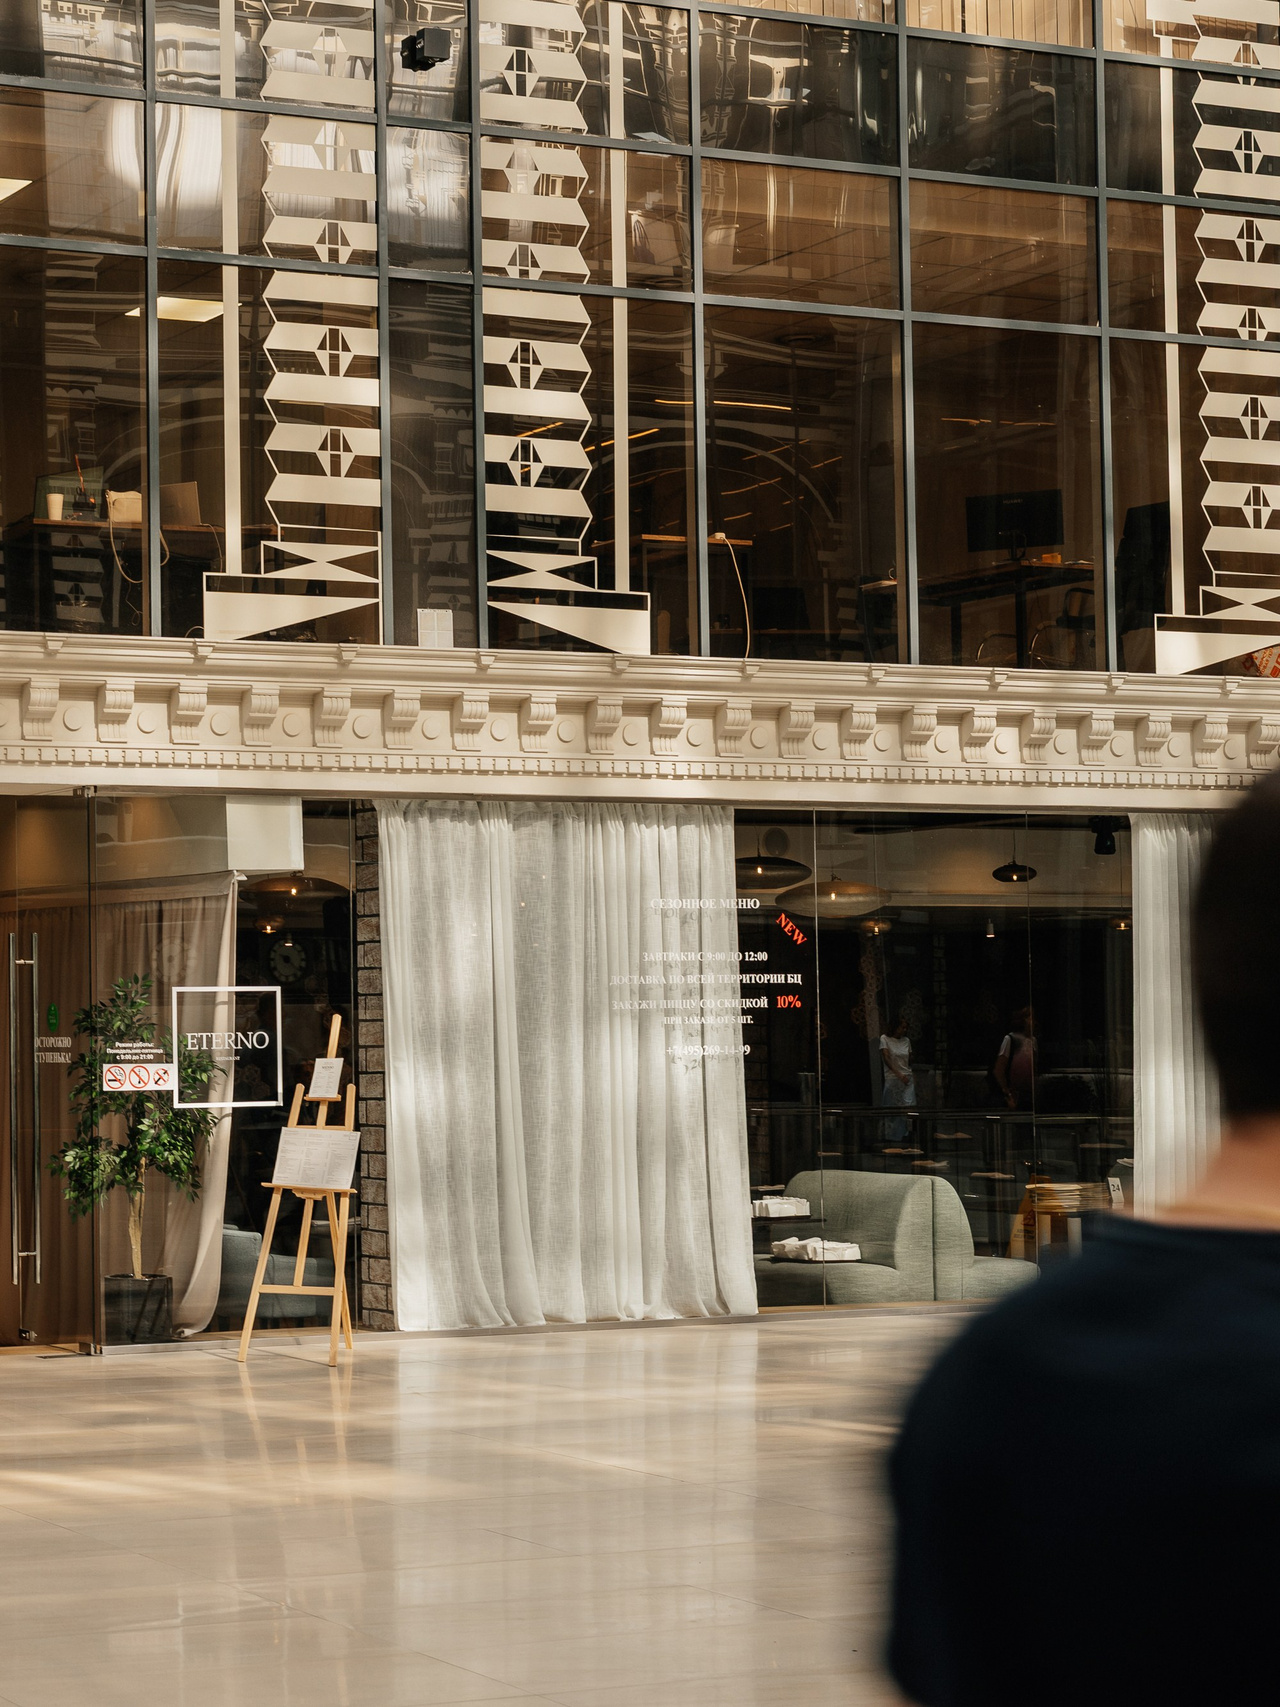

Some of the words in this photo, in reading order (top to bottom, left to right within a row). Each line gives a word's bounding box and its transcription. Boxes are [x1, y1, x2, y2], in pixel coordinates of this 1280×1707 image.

[650, 898, 717, 909] СЕЗОННОЕ
[720, 898, 760, 909] МЕНЮ
[775, 912, 808, 945] NEW
[642, 952, 695, 962] ЗАВТРАКИ
[697, 952, 705, 961] С
[707, 951, 726, 961] 9:00
[728, 952, 743, 962] ДО
[744, 951, 768, 961] 12:00
[609, 975, 667, 986] ДОСТАВКА
[669, 974, 685, 984] ПО
[687, 972, 715, 984] ВСЕЙ
[717, 973, 786, 984] ТЕРРИТОРИИ
[787, 973, 803, 985] БЦ
[612, 1000, 657, 1010] ЗАКАЖИ
[660, 999, 698, 1010] ПИЦЦУ
[700, 998, 715, 1009] СО
[717, 996, 769, 1010] СКИДКОЙ
[776, 995, 802, 1008] 10%
[664, 1016, 682, 1025] ПРИ
[683, 1016, 716, 1025] ЗАКАЗЕ
[717, 1016, 729, 1024] ОТ
[737, 1015, 754, 1024] ШТ.
[34, 1036, 72, 1048] ОСТОРОЖНО
[185, 1031, 270, 1050] ETERNO
[34, 1052, 72, 1064] СТУПЕНЬКА!
[1111, 1183, 1121, 1192] 24
